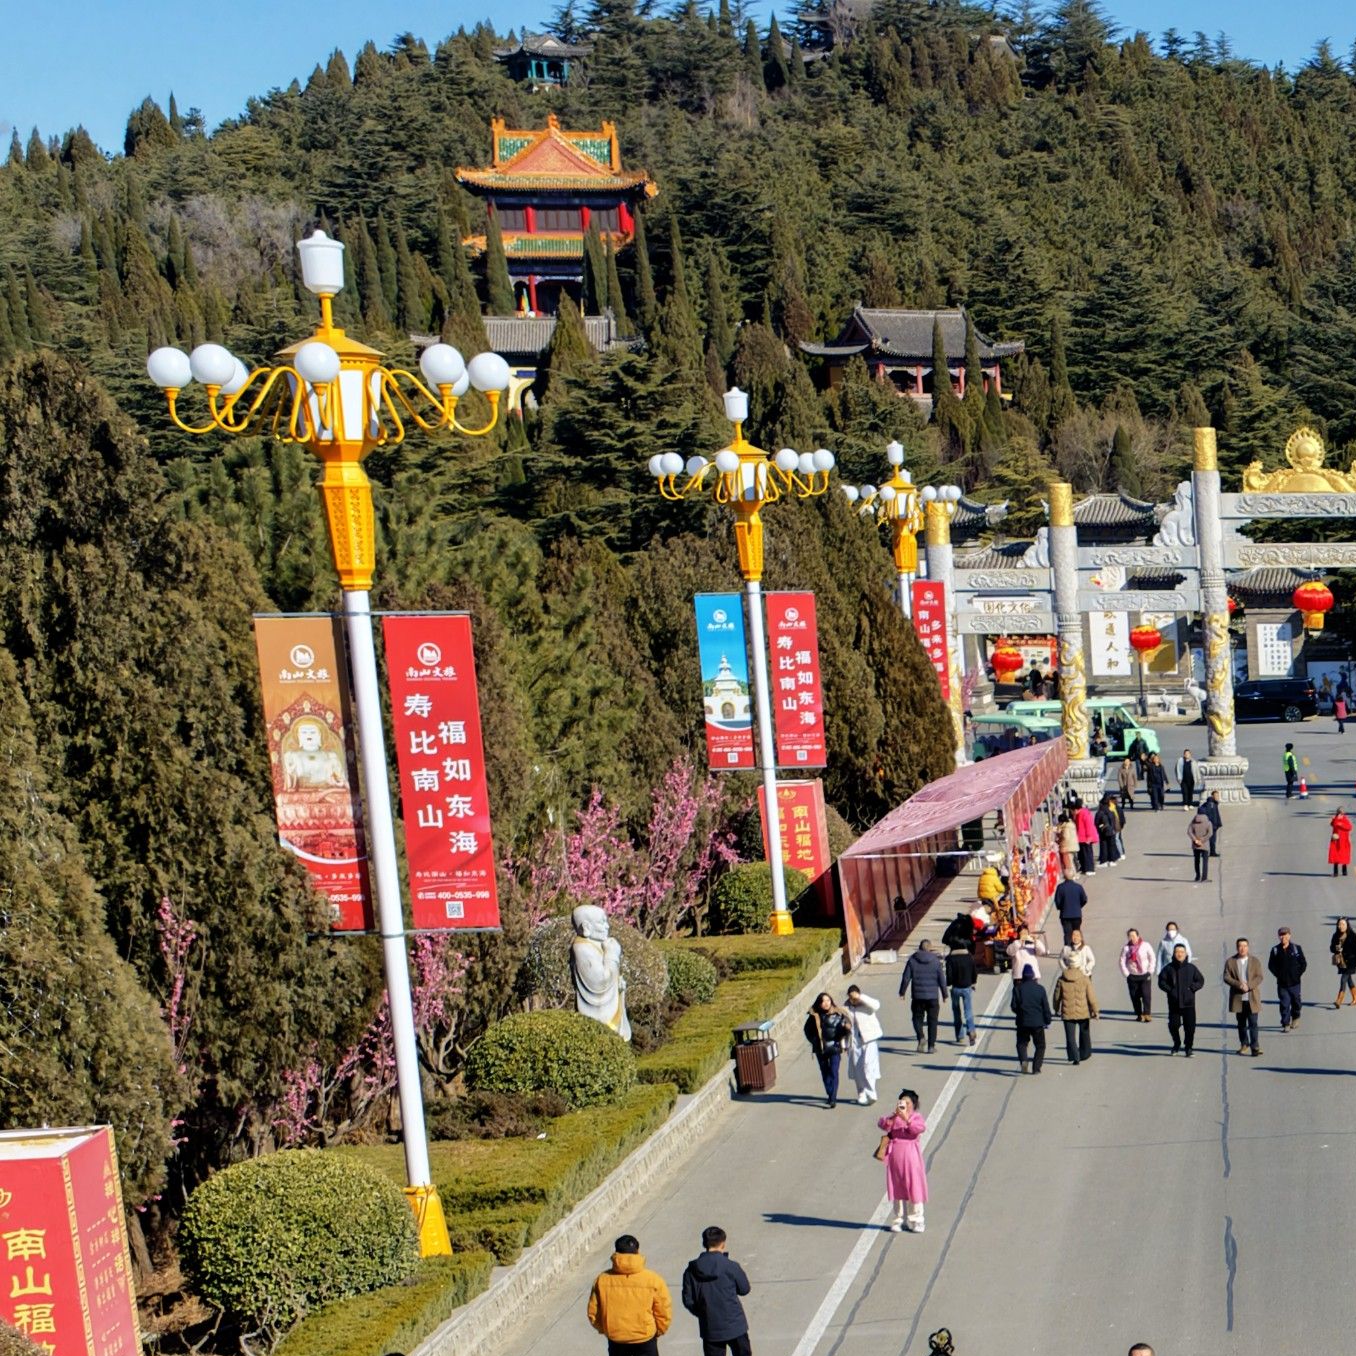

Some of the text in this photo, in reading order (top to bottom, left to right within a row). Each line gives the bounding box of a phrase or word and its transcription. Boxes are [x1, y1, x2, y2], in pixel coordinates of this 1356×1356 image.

[776, 636, 798, 711] 寿比南山
[795, 650, 817, 726] 福如东海
[404, 693, 443, 829] 寿比南山
[438, 721, 478, 855] 福如东海
